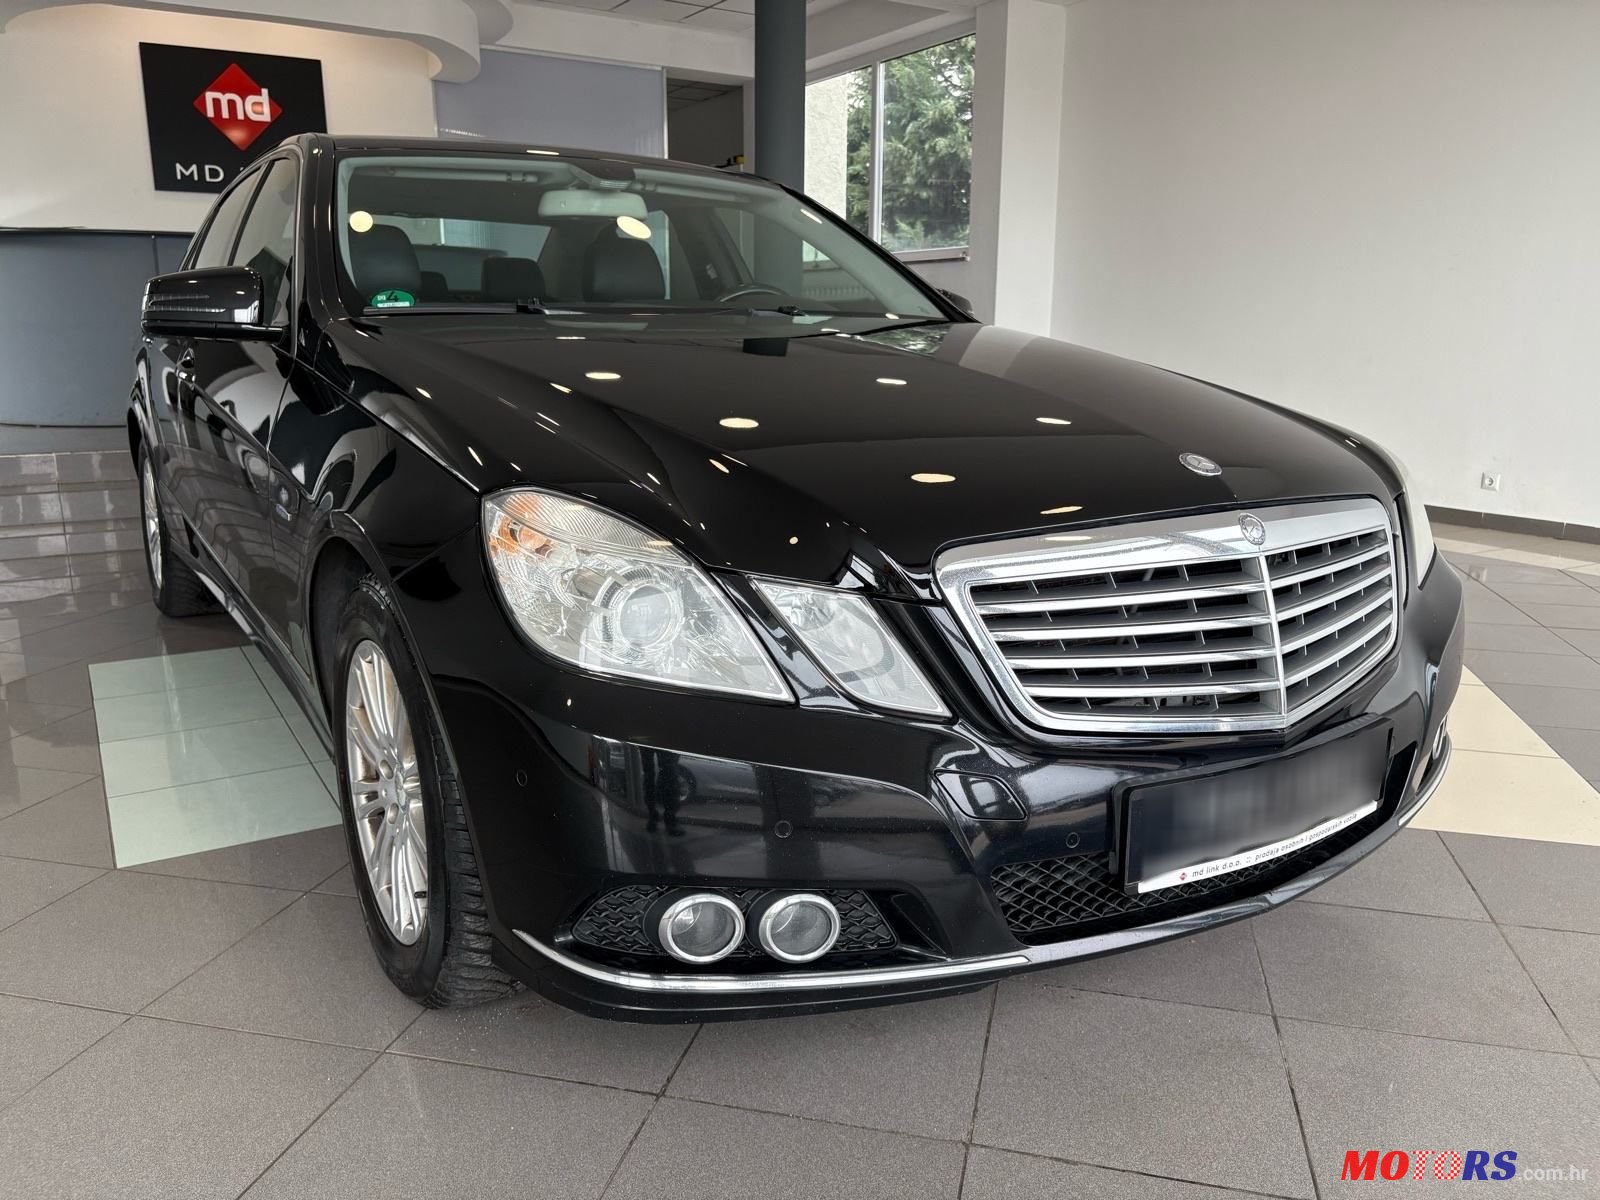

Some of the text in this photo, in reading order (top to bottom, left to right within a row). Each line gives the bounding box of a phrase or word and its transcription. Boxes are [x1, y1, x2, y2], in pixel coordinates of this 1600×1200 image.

[205, 88, 271, 122] md
[175, 163, 224, 182] MD
[386, 291, 398, 302] 4
[1192, 867, 1204, 877] md
[1206, 864, 1220, 874] link
